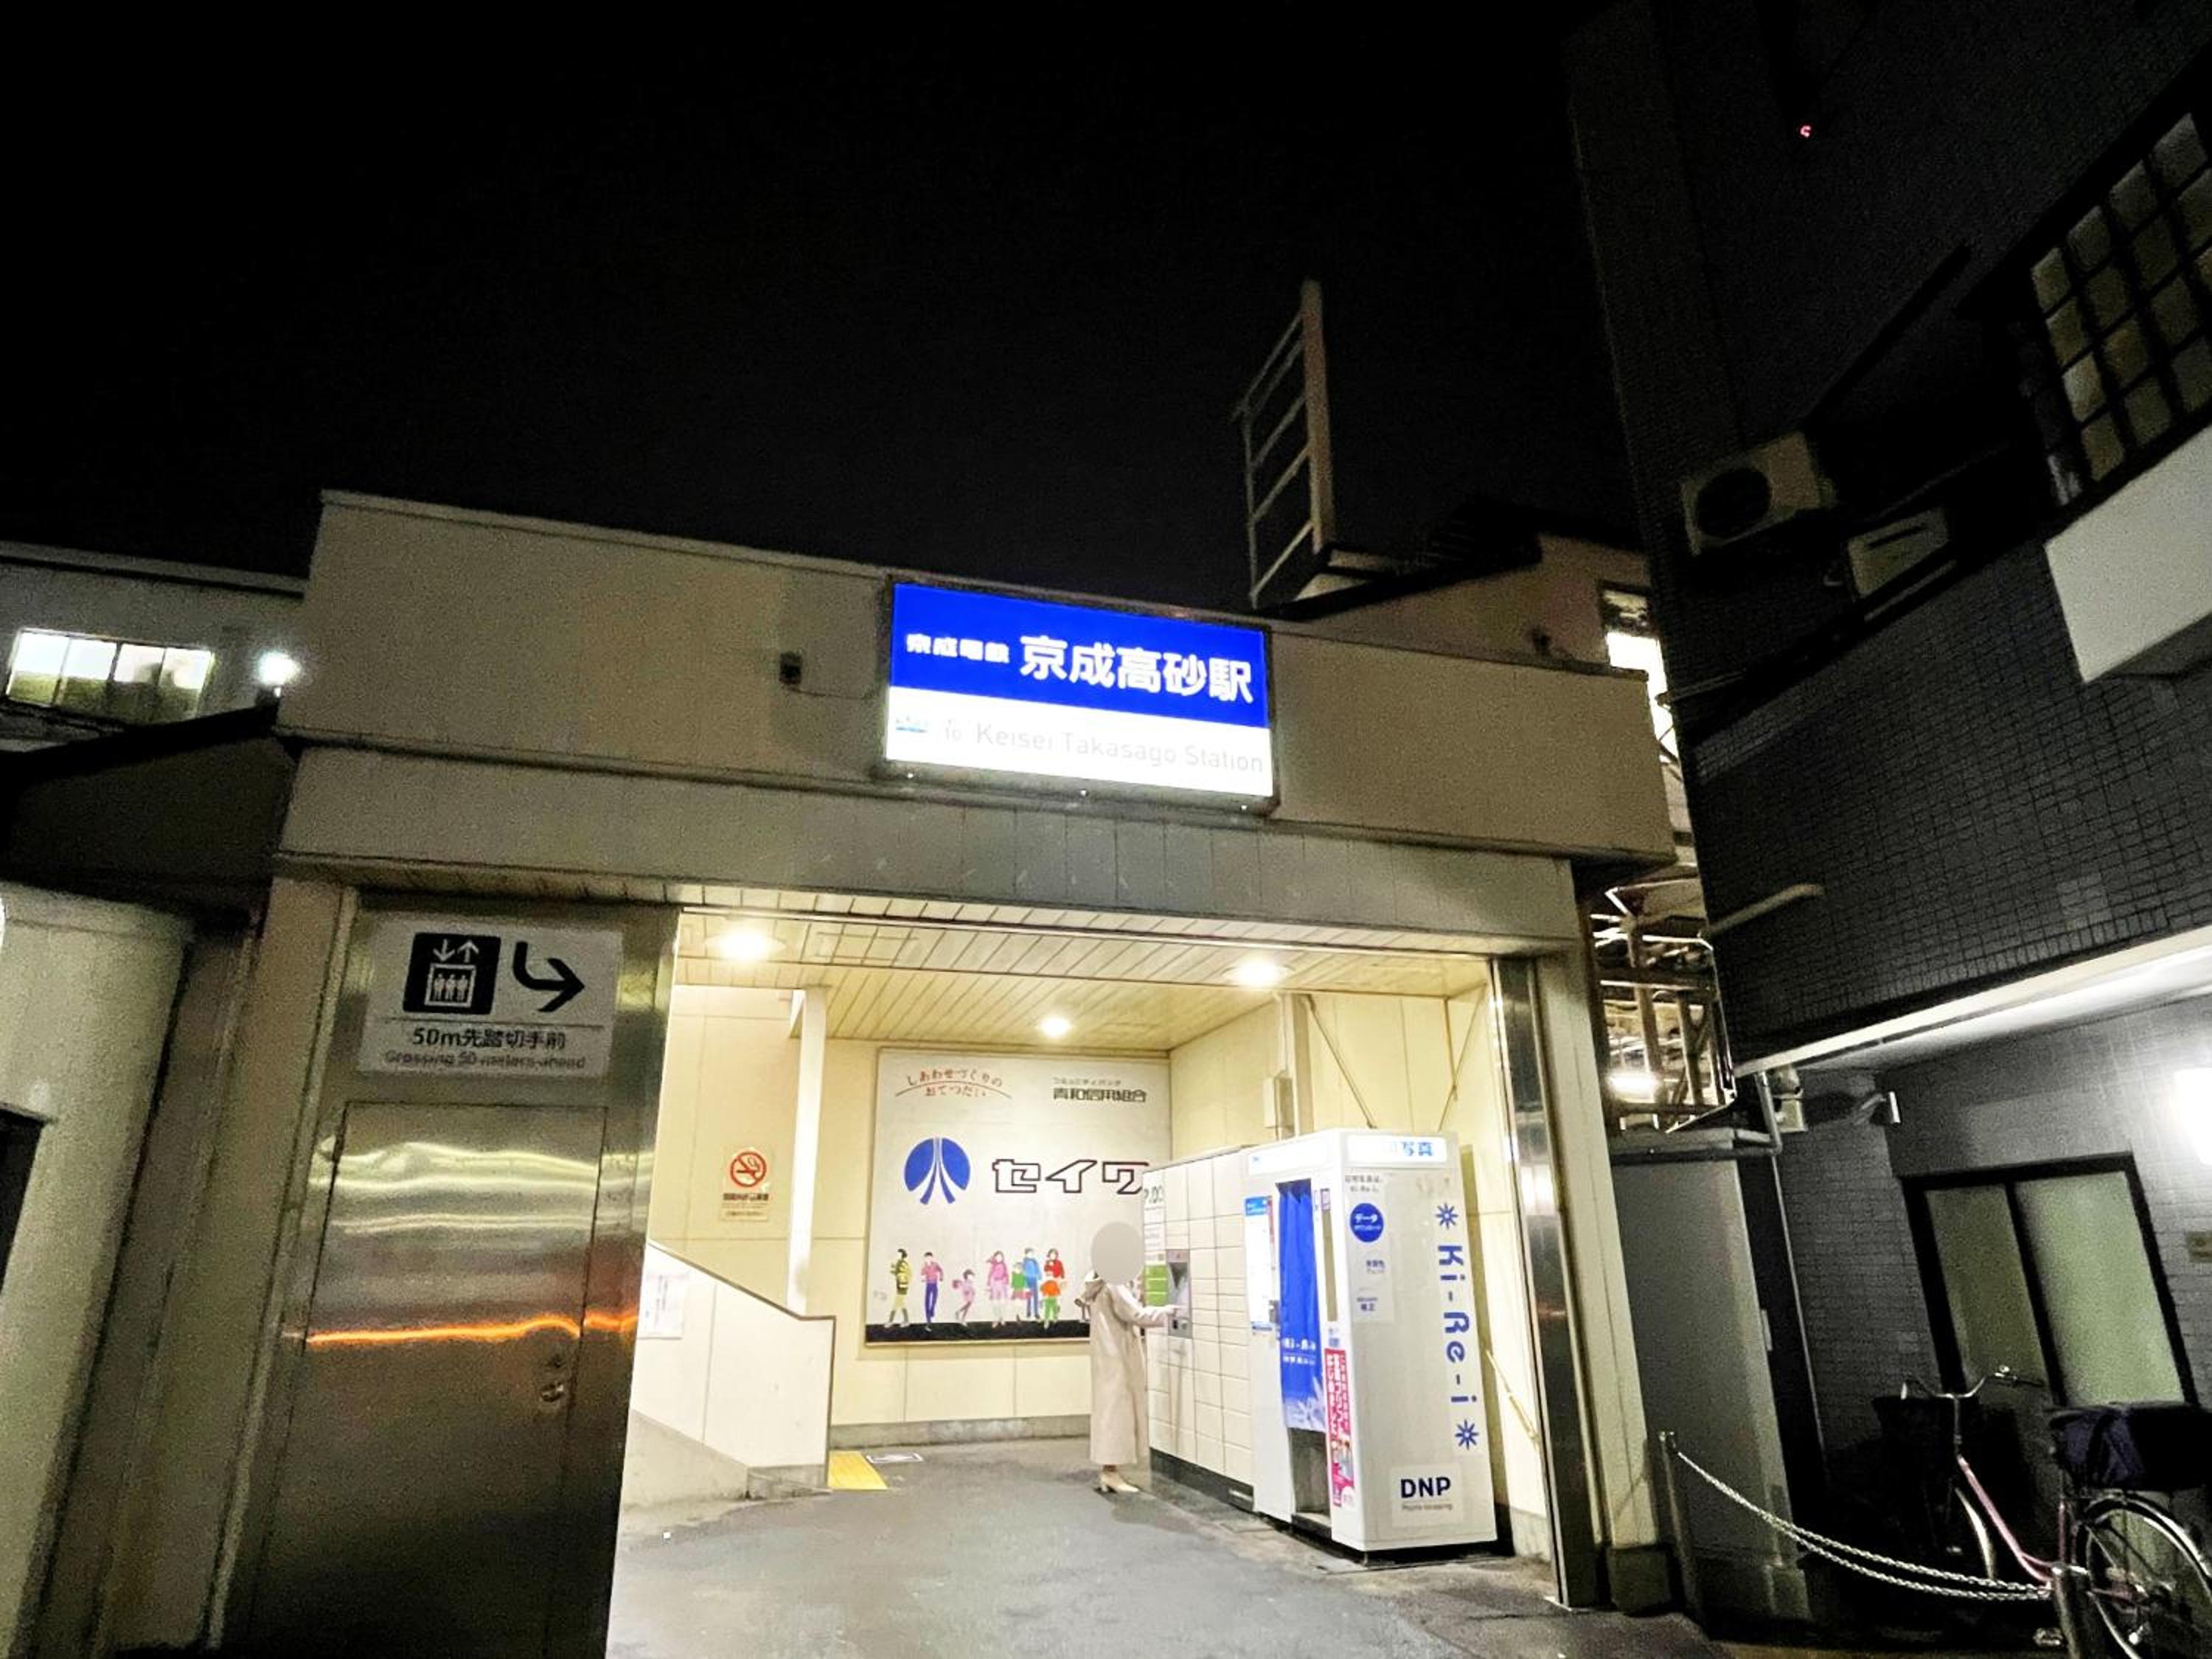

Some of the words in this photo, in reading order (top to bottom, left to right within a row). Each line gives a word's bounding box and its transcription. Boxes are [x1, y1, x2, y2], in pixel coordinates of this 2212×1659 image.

[1020, 635, 1254, 704] 京成高砂駅
[975, 722, 1054, 751] Keisei
[1062, 731, 1177, 768] Takasago
[1185, 743, 1265, 773] Station
[412, 1027, 566, 1050] 50m先踏切手前
[992, 1158, 1150, 1195] セイワ
[1400, 1476, 1451, 1499] DNP
